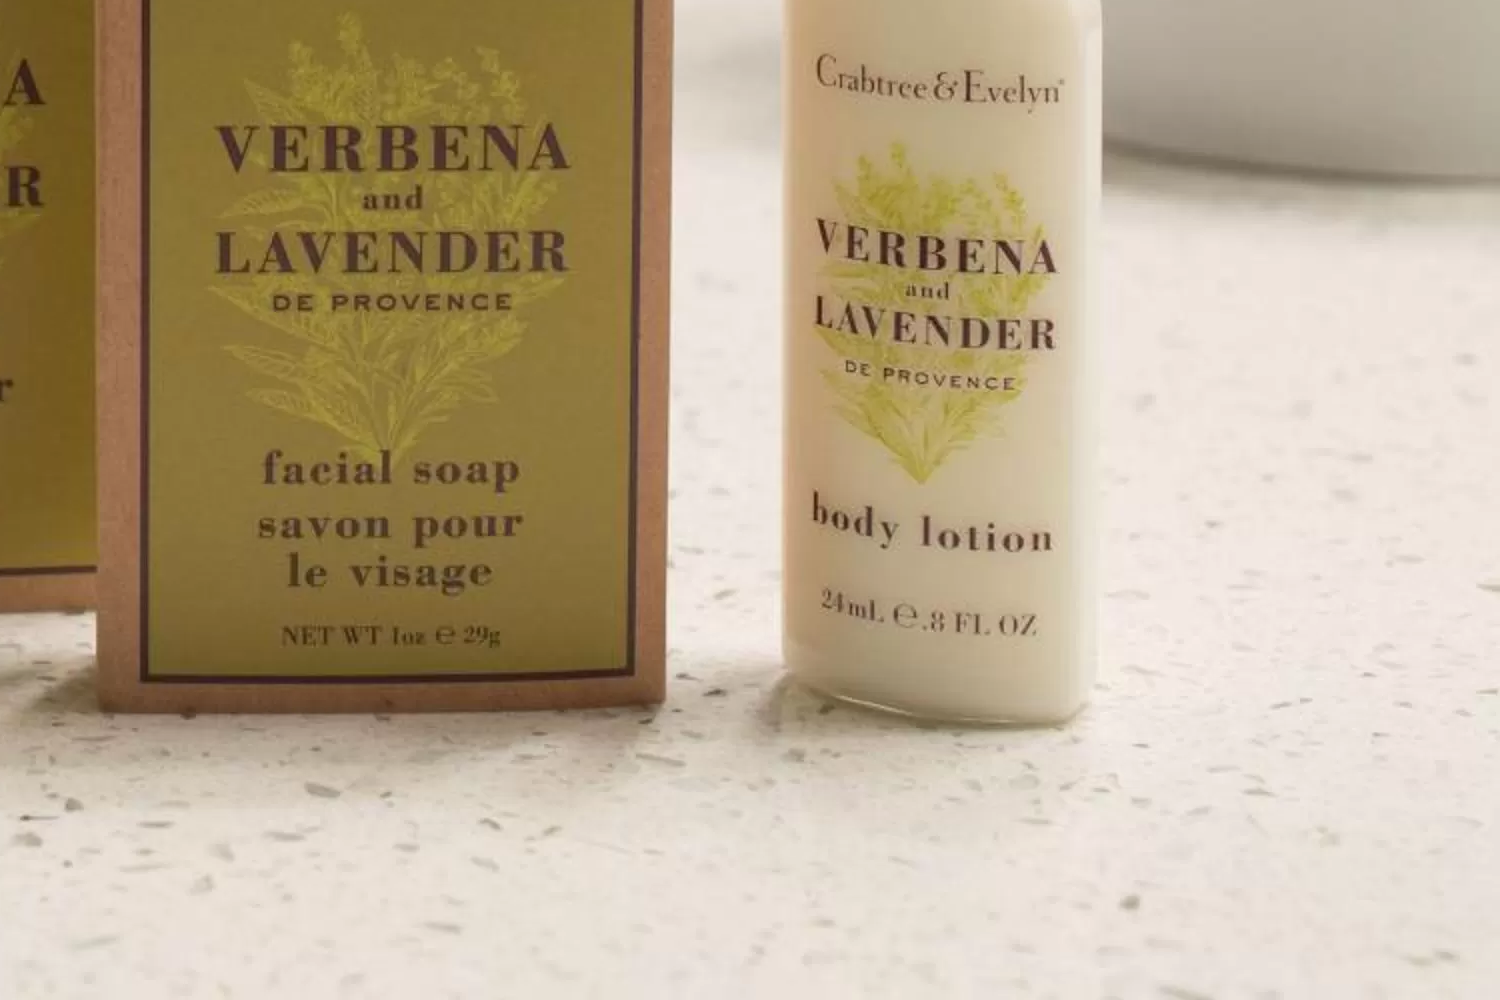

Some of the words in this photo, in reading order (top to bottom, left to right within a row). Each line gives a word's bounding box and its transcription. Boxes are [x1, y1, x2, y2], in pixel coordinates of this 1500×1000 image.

[816, 54, 928, 100] Crabtree
[214, 123, 571, 172] VERBENA
[362, 186, 424, 211] and
[215, 231, 569, 274] LAVENDER
[816, 218, 1058, 275] VERBENA
[272, 294, 312, 312] DE
[331, 293, 512, 311] PROVENCE
[905, 282, 950, 301] and
[816, 296, 1056, 350] LAVENDER
[845, 360, 870, 377] DE
[883, 366, 1015, 391] PROVENCE
[262, 449, 392, 484] facial
[414, 456, 519, 492] soap
[258, 516, 391, 539] savon
[414, 516, 522, 548] pour
[811, 491, 900, 549] body
[921, 515, 1053, 553] lotion
[287, 554, 328, 588] le
[350, 554, 492, 596] visage
[282, 626, 335, 646] NET
[341, 626, 382, 645] WT
[462, 626, 501, 648] 29g
[955, 613, 991, 636] FL
[999, 613, 1037, 637] OZ
